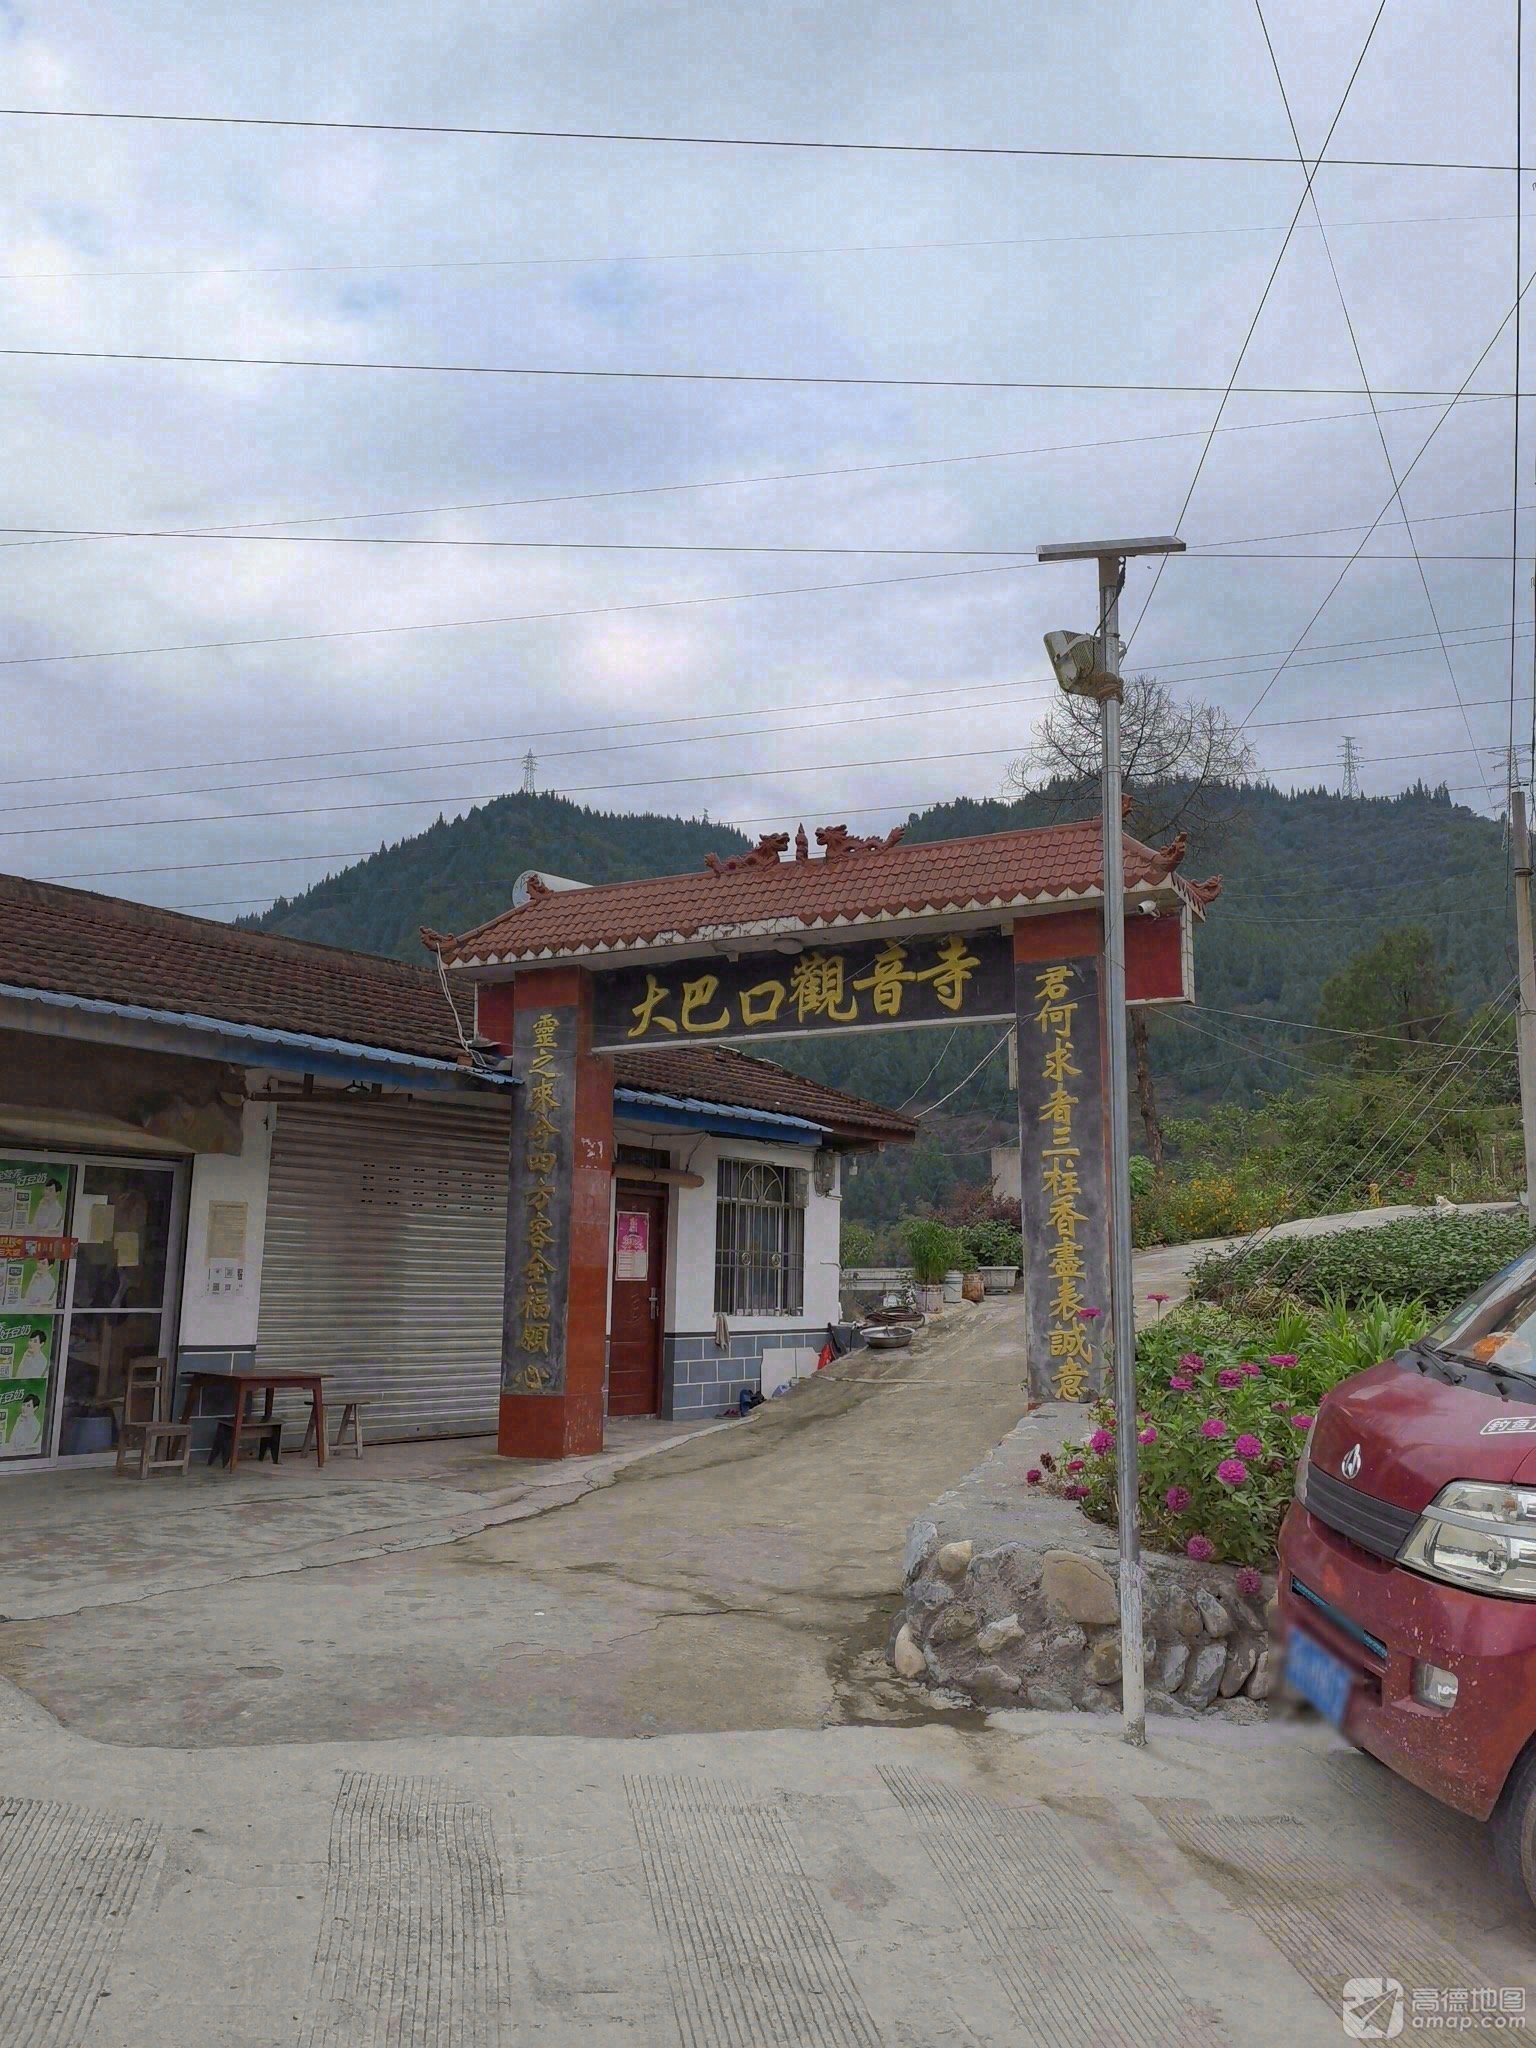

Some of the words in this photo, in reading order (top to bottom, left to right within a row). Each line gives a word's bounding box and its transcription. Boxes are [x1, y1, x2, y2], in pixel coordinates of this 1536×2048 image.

[628, 935, 981, 1038] 大巴口觀音寺
[1034, 963, 1092, 1401] 君何求者三柱香盡表誠意
